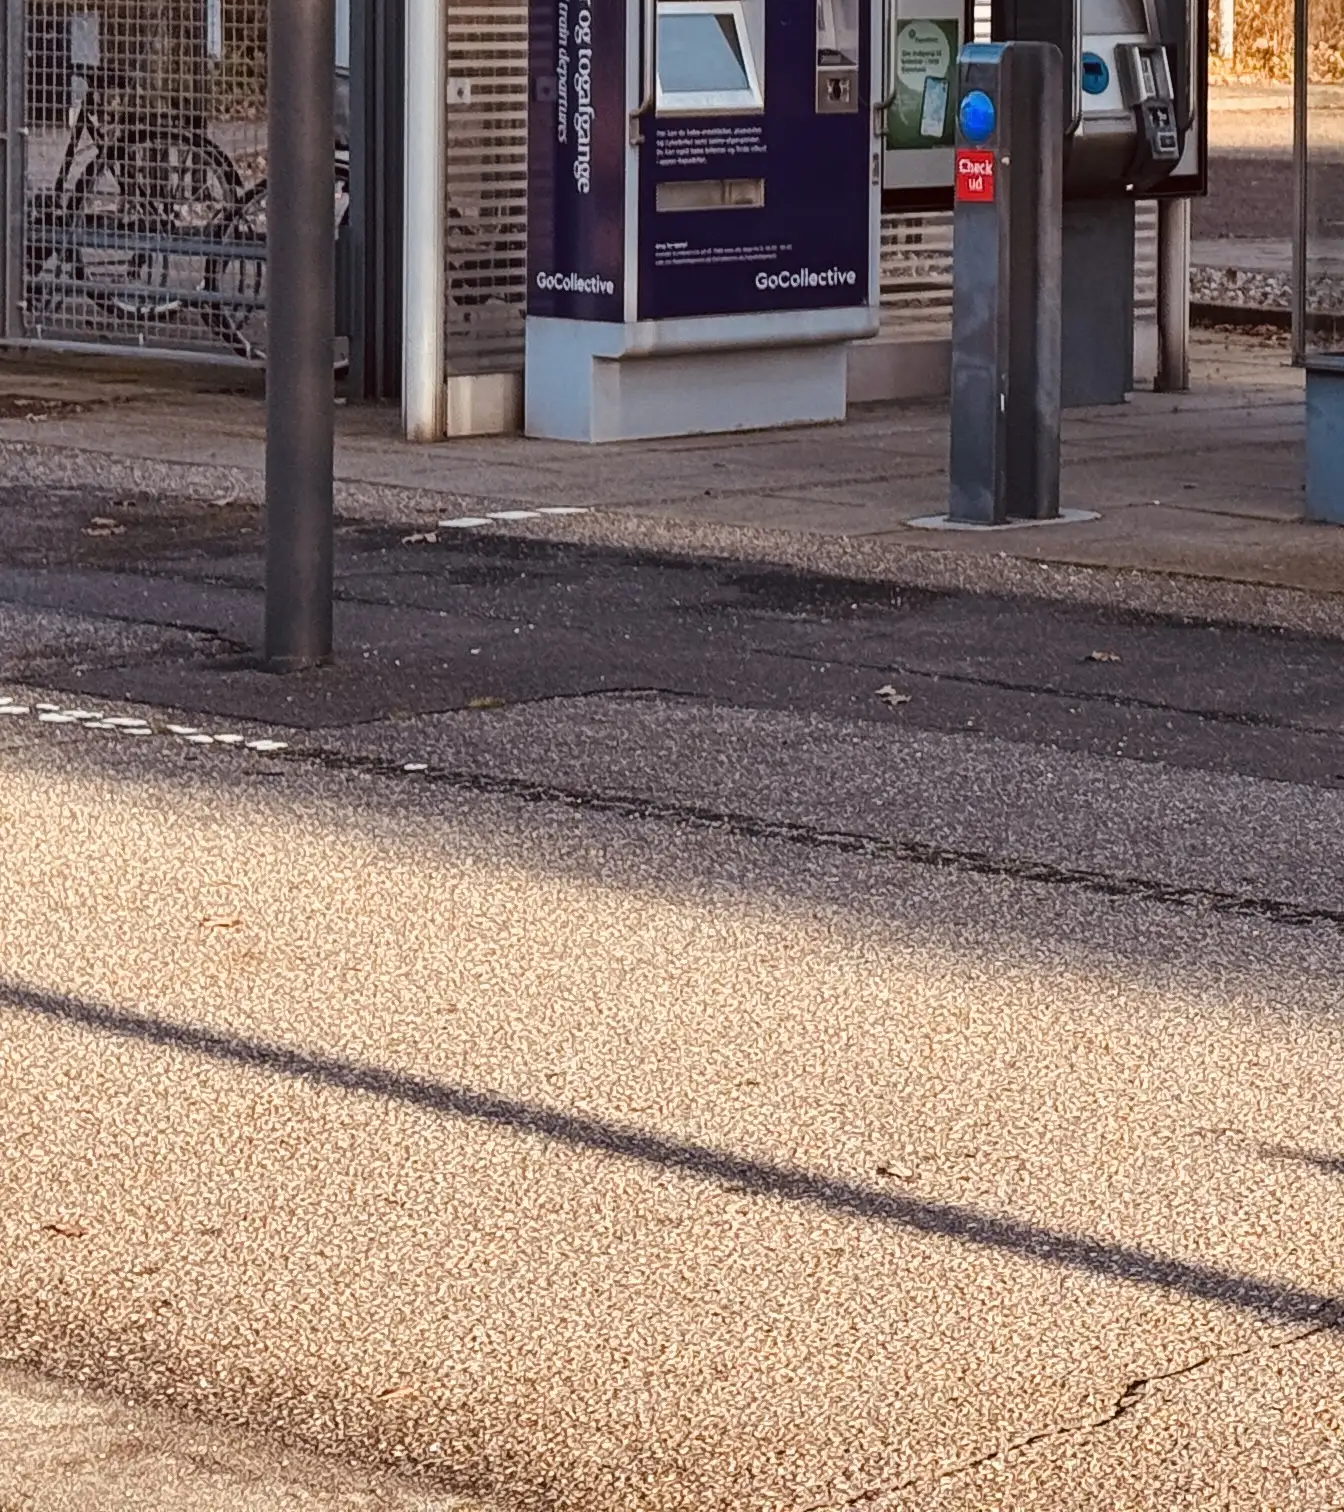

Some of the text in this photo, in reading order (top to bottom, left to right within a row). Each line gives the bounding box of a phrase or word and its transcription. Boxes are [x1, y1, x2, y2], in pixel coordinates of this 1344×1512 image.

[558, 4, 570, 45] train
[574, 9, 592, 45] og
[556, 49, 570, 144] departures
[574, 48, 595, 194] togafgange
[958, 158, 993, 176] Check
[968, 175, 983, 192] ud
[536, 271, 615, 295] GoCollective
[754, 267, 857, 290] GoCollective
